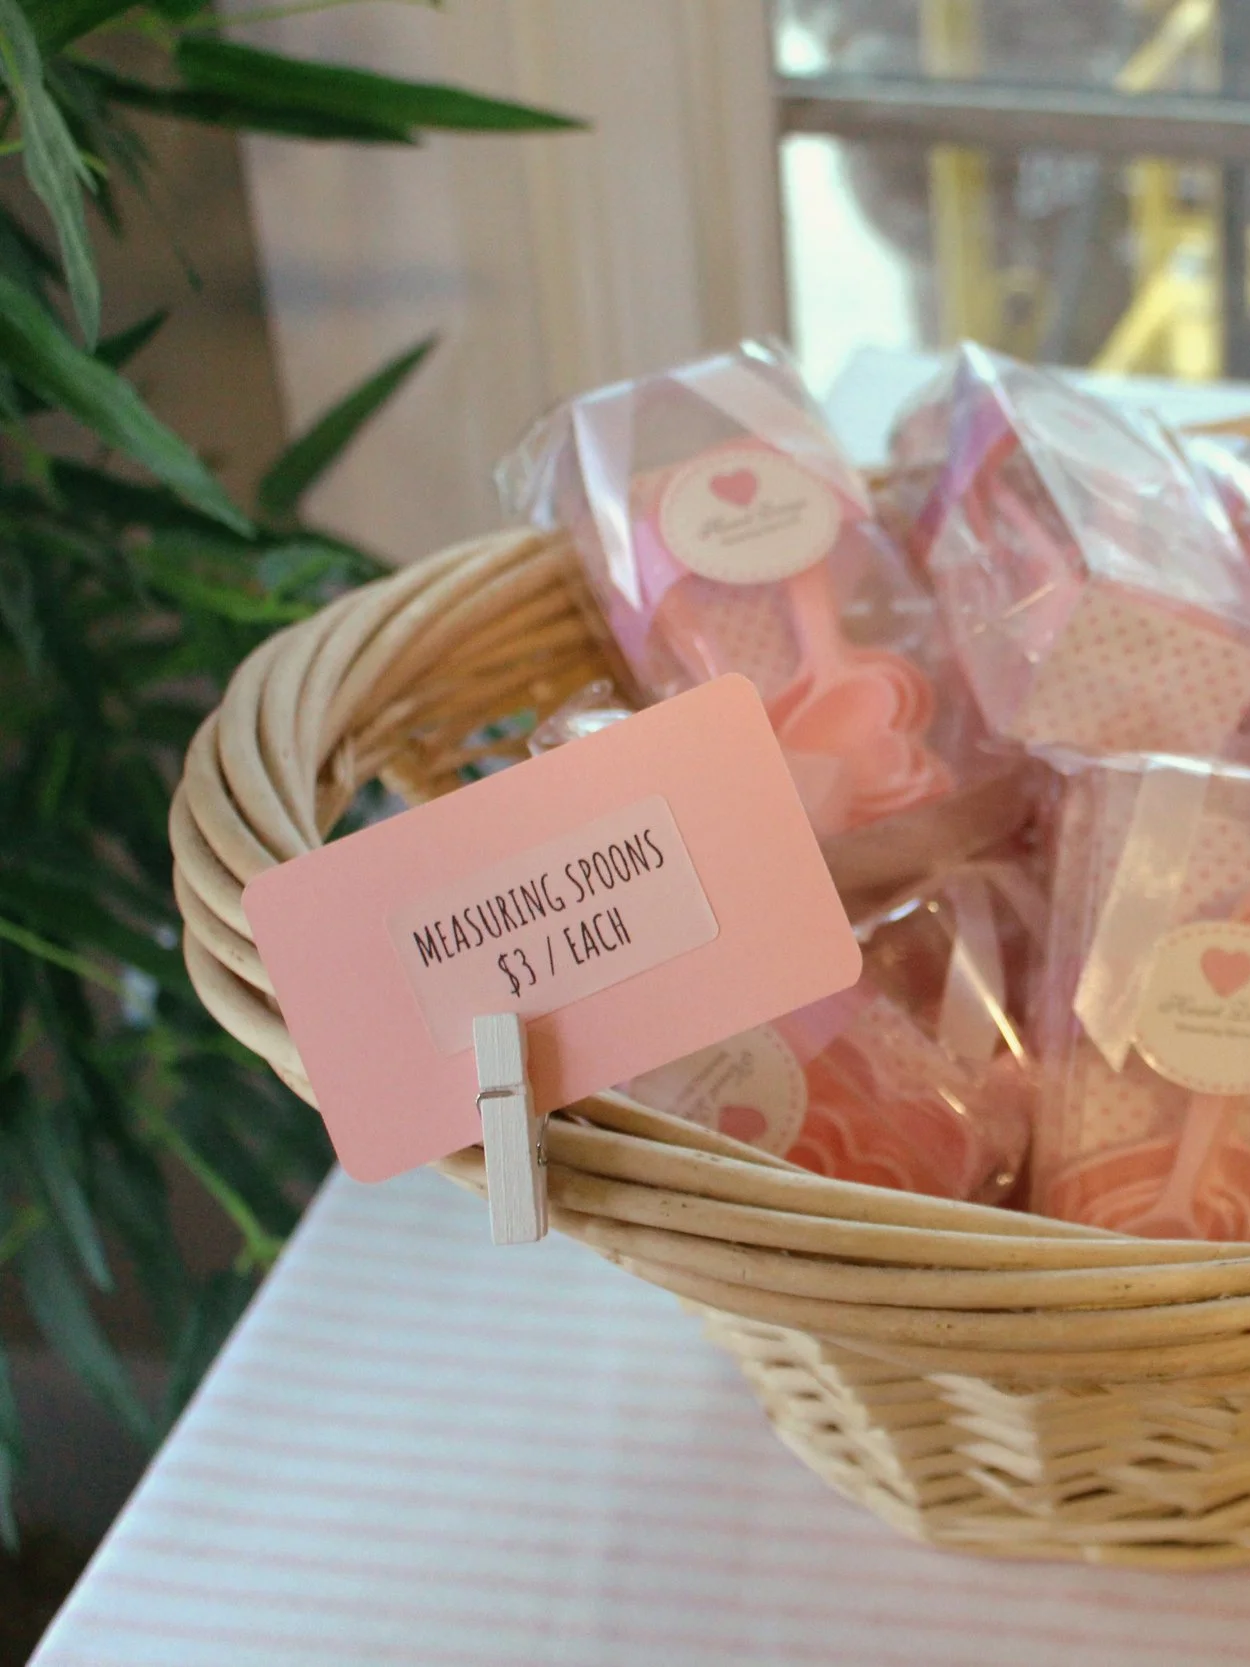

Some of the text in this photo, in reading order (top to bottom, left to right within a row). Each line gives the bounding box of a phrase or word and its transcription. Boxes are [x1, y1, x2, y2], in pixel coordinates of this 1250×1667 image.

[412, 828, 664, 968] MEASURING SPOONS
[497, 906, 631, 998] $3 / EACH
